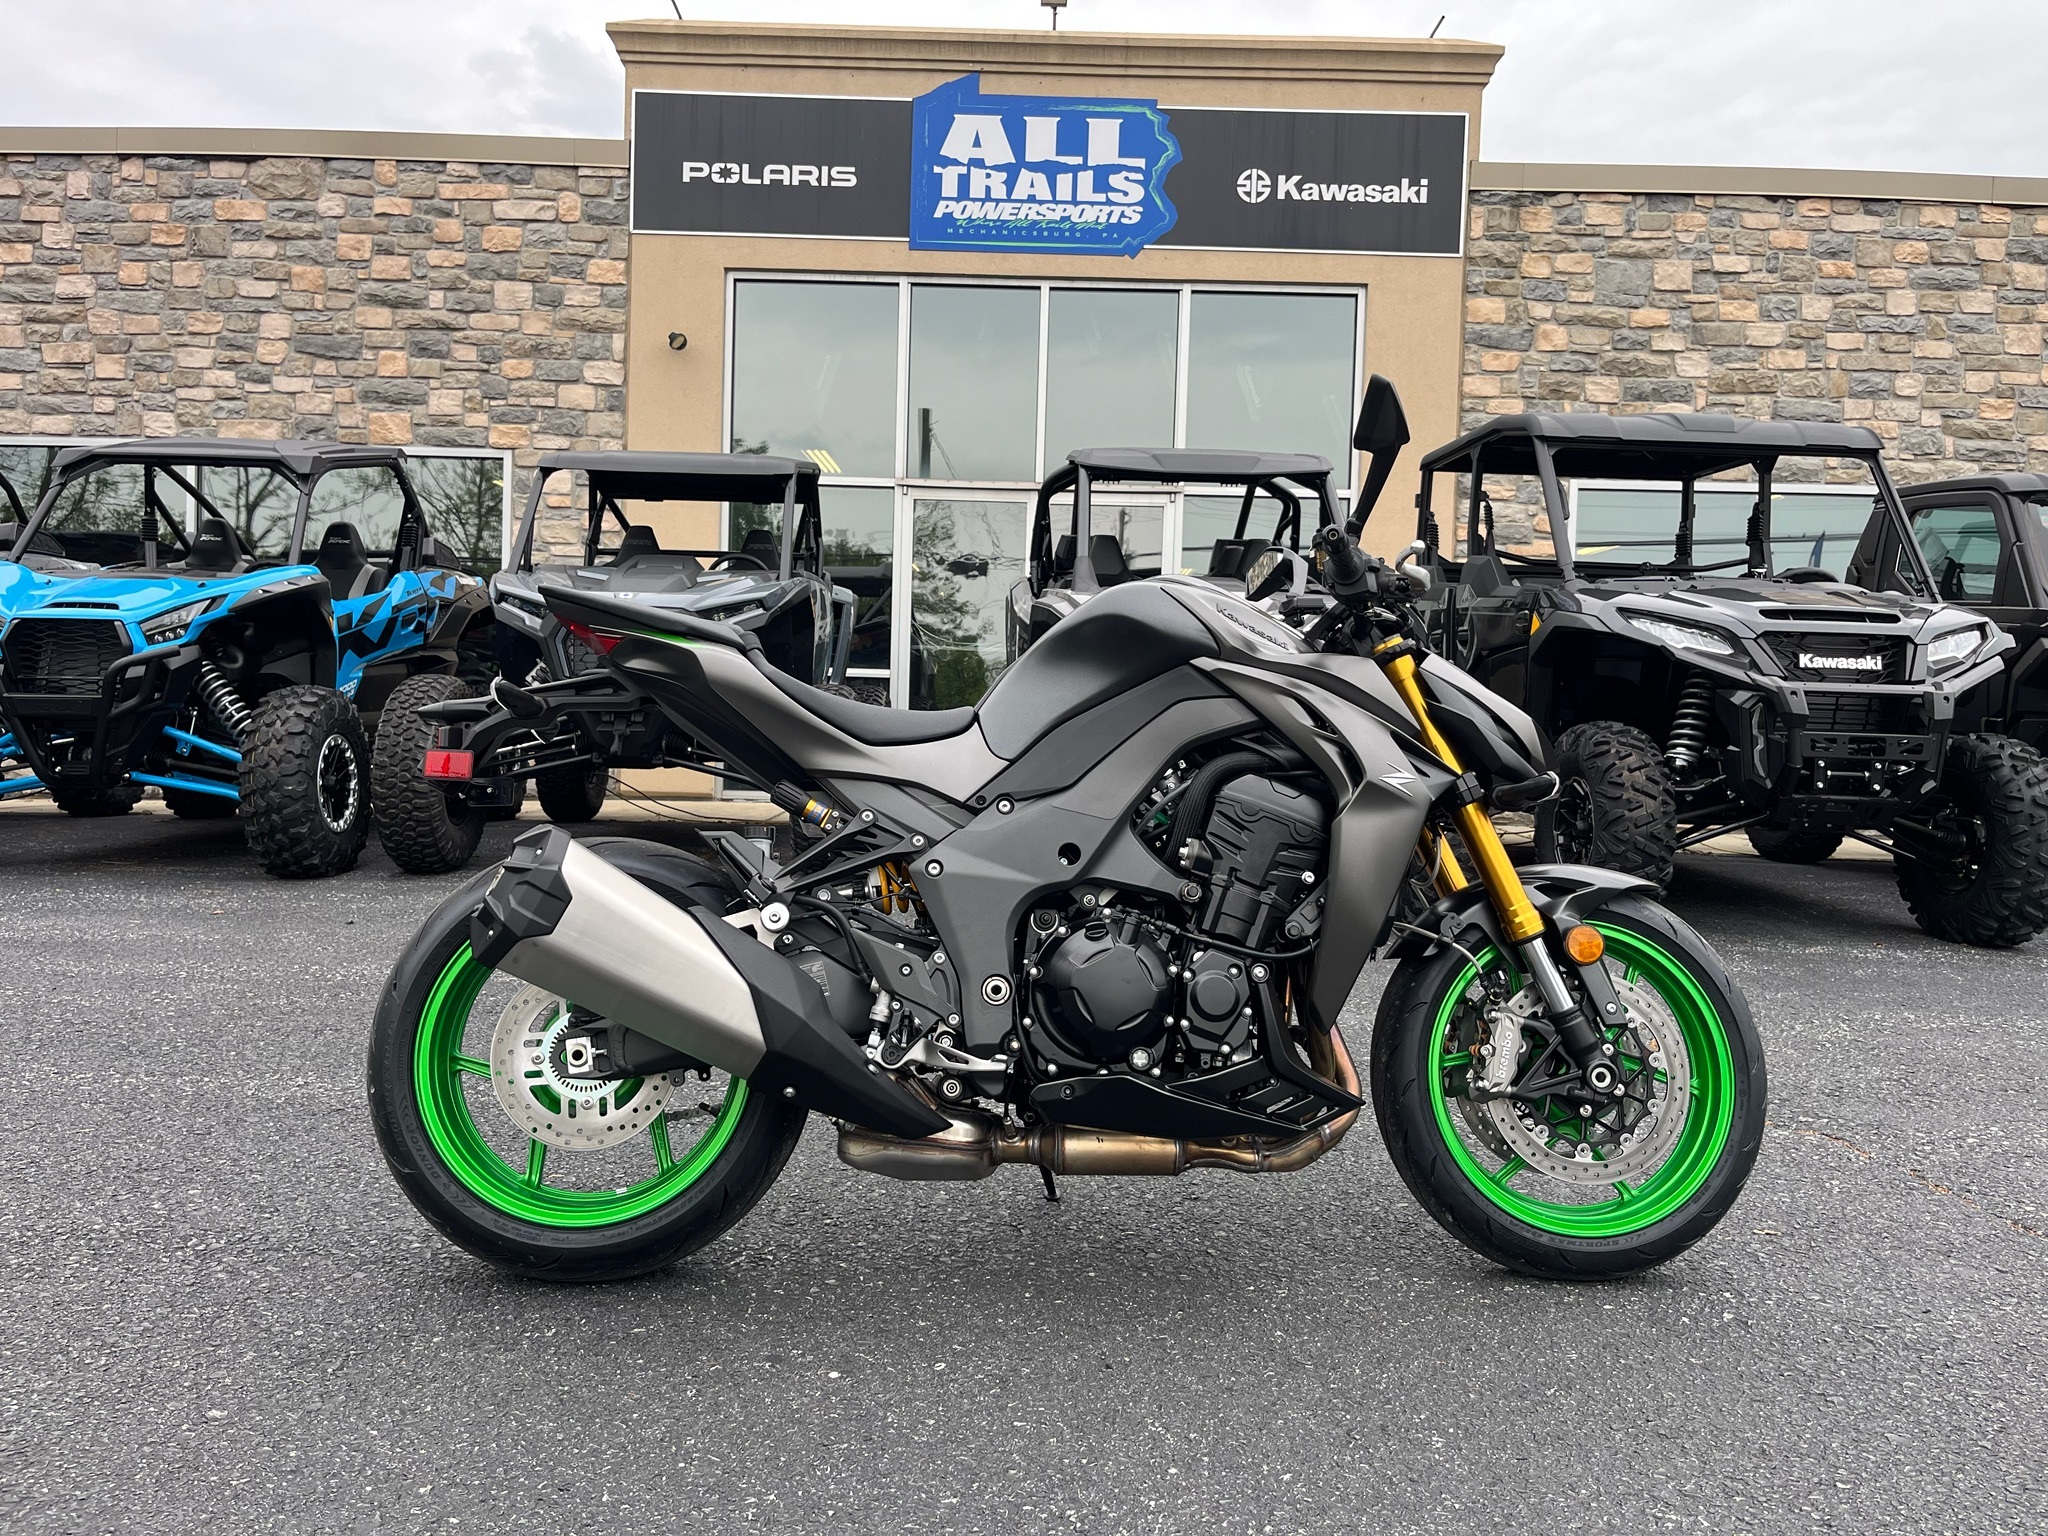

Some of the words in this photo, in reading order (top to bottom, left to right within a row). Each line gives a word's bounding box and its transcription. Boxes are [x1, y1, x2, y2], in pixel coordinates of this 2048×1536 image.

[939, 114, 1146, 171] ALL
[682, 161, 858, 188] POLARIS
[933, 165, 1146, 204] TRAILS
[1277, 174, 1429, 204] Kawasaki
[933, 200, 1144, 225] POWERSPORTS
[1216, 602, 1290, 651] Kawasaki
[1799, 653, 1883, 670] Kawasaki
[1495, 1031, 1513, 1079] brembo
[406, 1122, 440, 1180] DUNLOP
[1549, 1237, 1620, 1248] SPORTMAX
